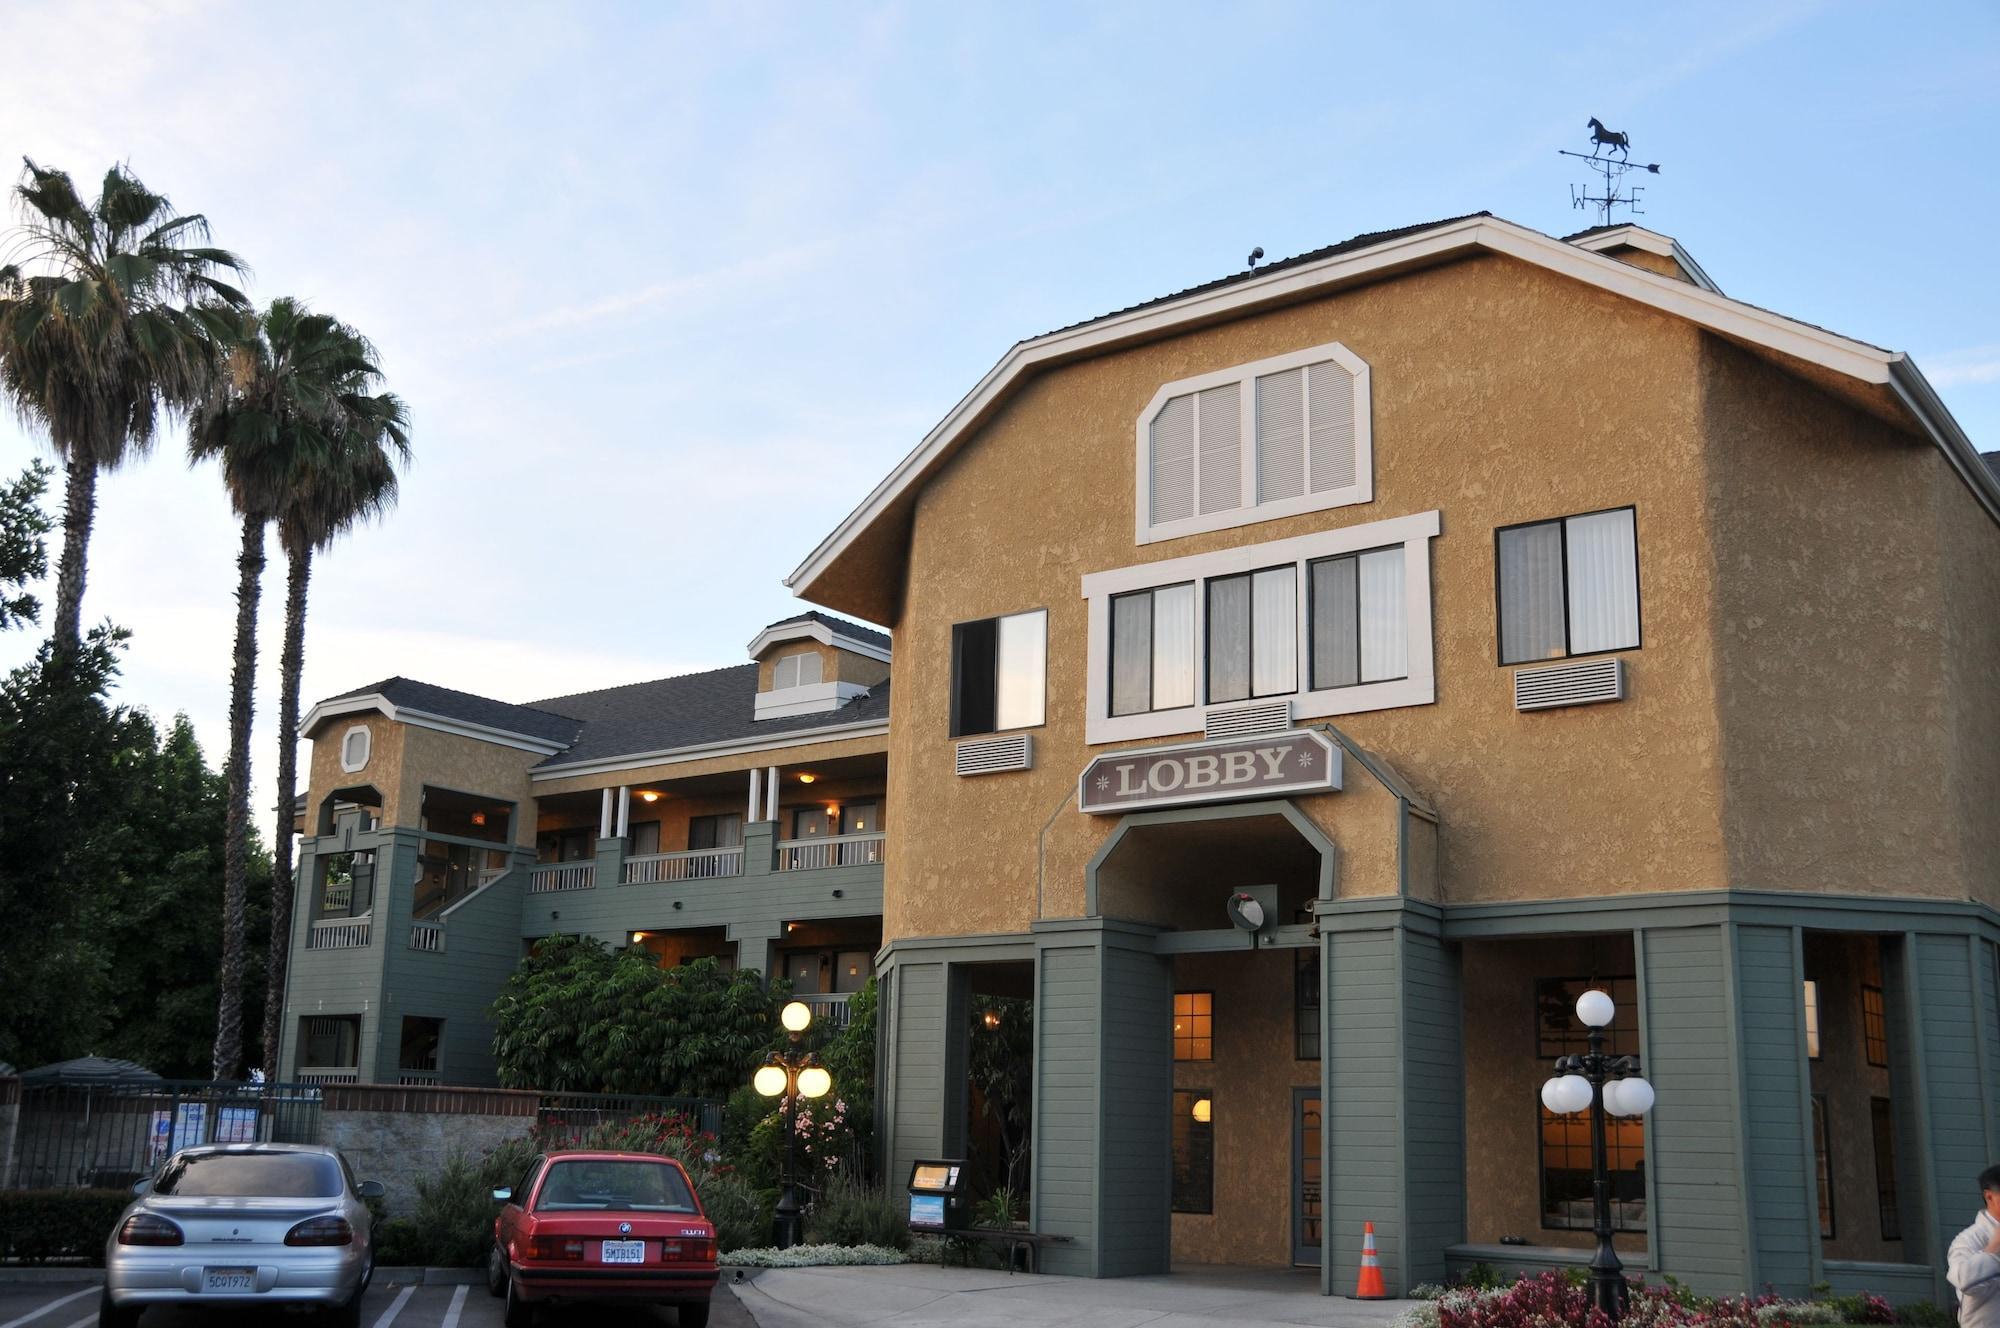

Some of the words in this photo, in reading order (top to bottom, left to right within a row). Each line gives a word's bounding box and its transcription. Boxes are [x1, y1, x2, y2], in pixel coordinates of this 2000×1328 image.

[1570, 183, 1586, 210] W
[1631, 186, 1645, 214] E
[1115, 745, 1293, 797] LOBBY
[209, 1275, 251, 1288] 5CQT972
